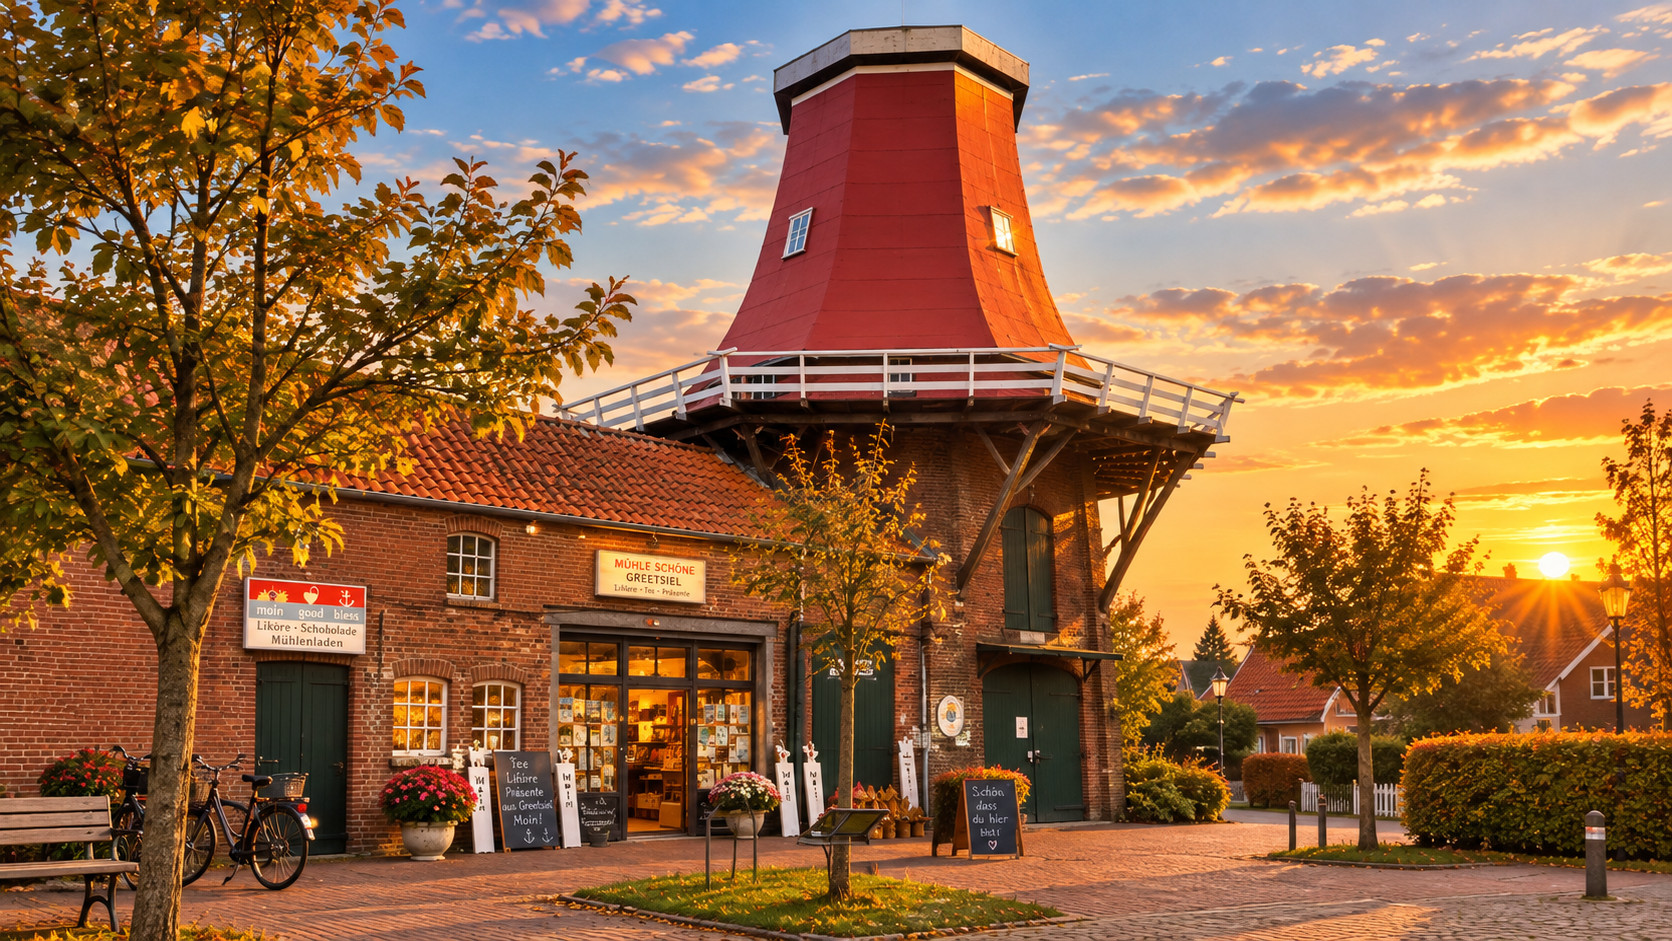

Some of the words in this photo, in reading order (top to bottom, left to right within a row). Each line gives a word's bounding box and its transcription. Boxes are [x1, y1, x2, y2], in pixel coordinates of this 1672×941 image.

[614, 558, 651, 571] MÜHLE
[655, 562, 696, 576] SCHÖNE
[626, 573, 682, 587] GREETSIEL
[256, 604, 284, 617] moin
[298, 608, 324, 620] good
[257, 620, 291, 632] Liköre
[271, 635, 343, 648] Mühlenladen
[972, 785, 1005, 797] Schön
[976, 800, 998, 811] dass
[513, 812, 542, 826] Moin!
[972, 814, 985, 824] du
[989, 813, 1009, 824] hier
